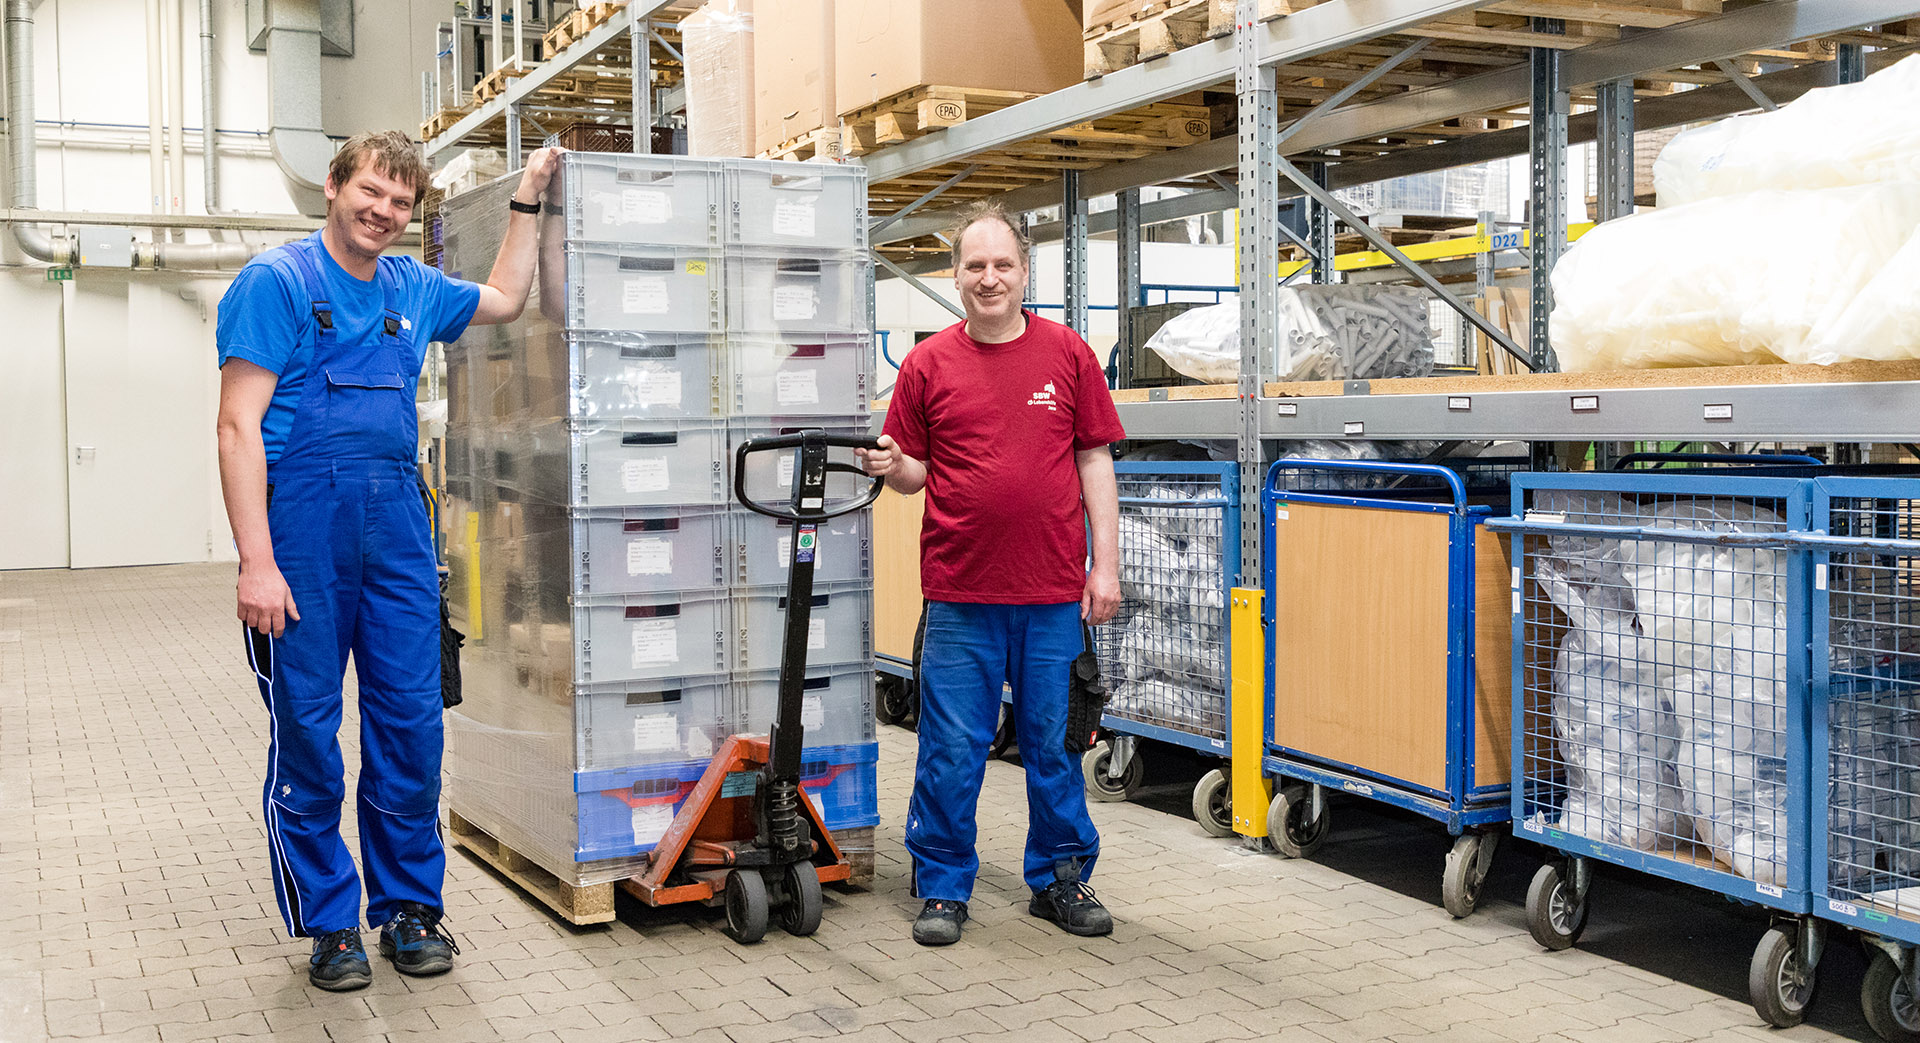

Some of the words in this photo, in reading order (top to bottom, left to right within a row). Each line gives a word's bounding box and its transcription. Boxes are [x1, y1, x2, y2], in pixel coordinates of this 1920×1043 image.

[939, 105, 957, 117] EPAL
[1493, 233, 1517, 248] D22
[1033, 392, 1050, 400] SBW
